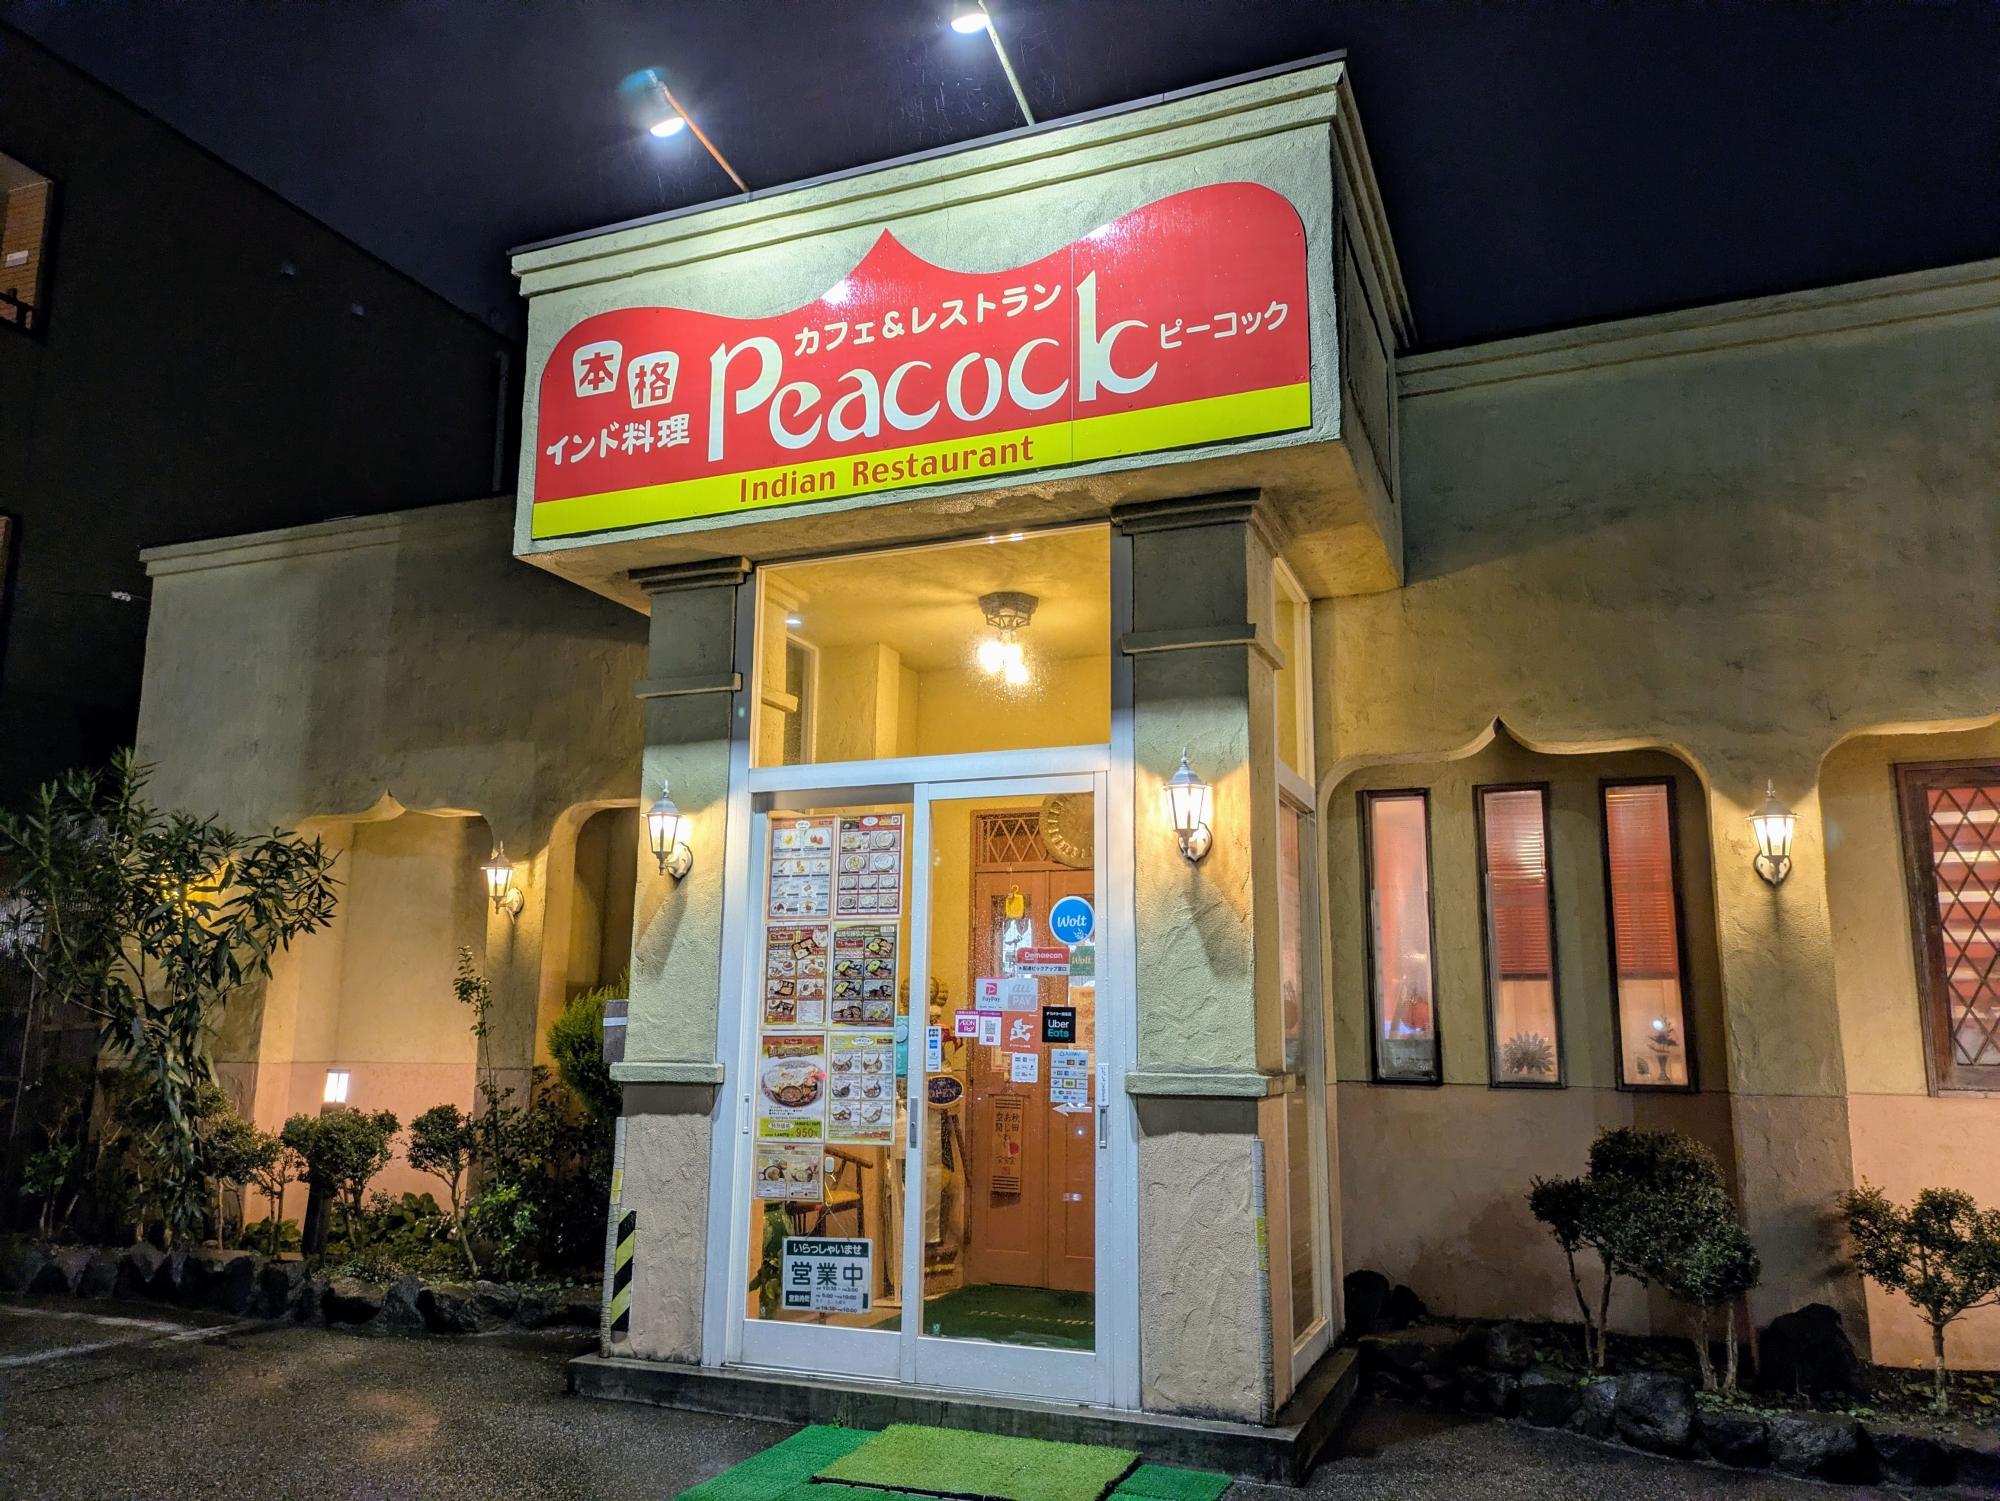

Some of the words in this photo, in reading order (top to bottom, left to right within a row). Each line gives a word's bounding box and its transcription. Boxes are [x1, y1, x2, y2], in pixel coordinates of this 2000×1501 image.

[795, 284, 1061, 356] カフェ&レストラン
[1160, 301, 1288, 349] ピーコック
[708, 270, 1158, 462] Peacock
[547, 413, 690, 466] インド料理
[740, 470, 836, 503] Indian
[853, 436, 1034, 487] Restaurant
[1057, 914, 1088, 928] Wolt
[1024, 951, 1063, 959] Demaecan
[1012, 984, 1030, 993] au
[1012, 995, 1031, 1007] PAY
[1047, 1019, 1070, 1029] Uber
[1047, 1028, 1070, 1038] Eats
[793, 1243, 863, 1255] いらっしゃいませ
[791, 1261, 864, 1287] 営業中
